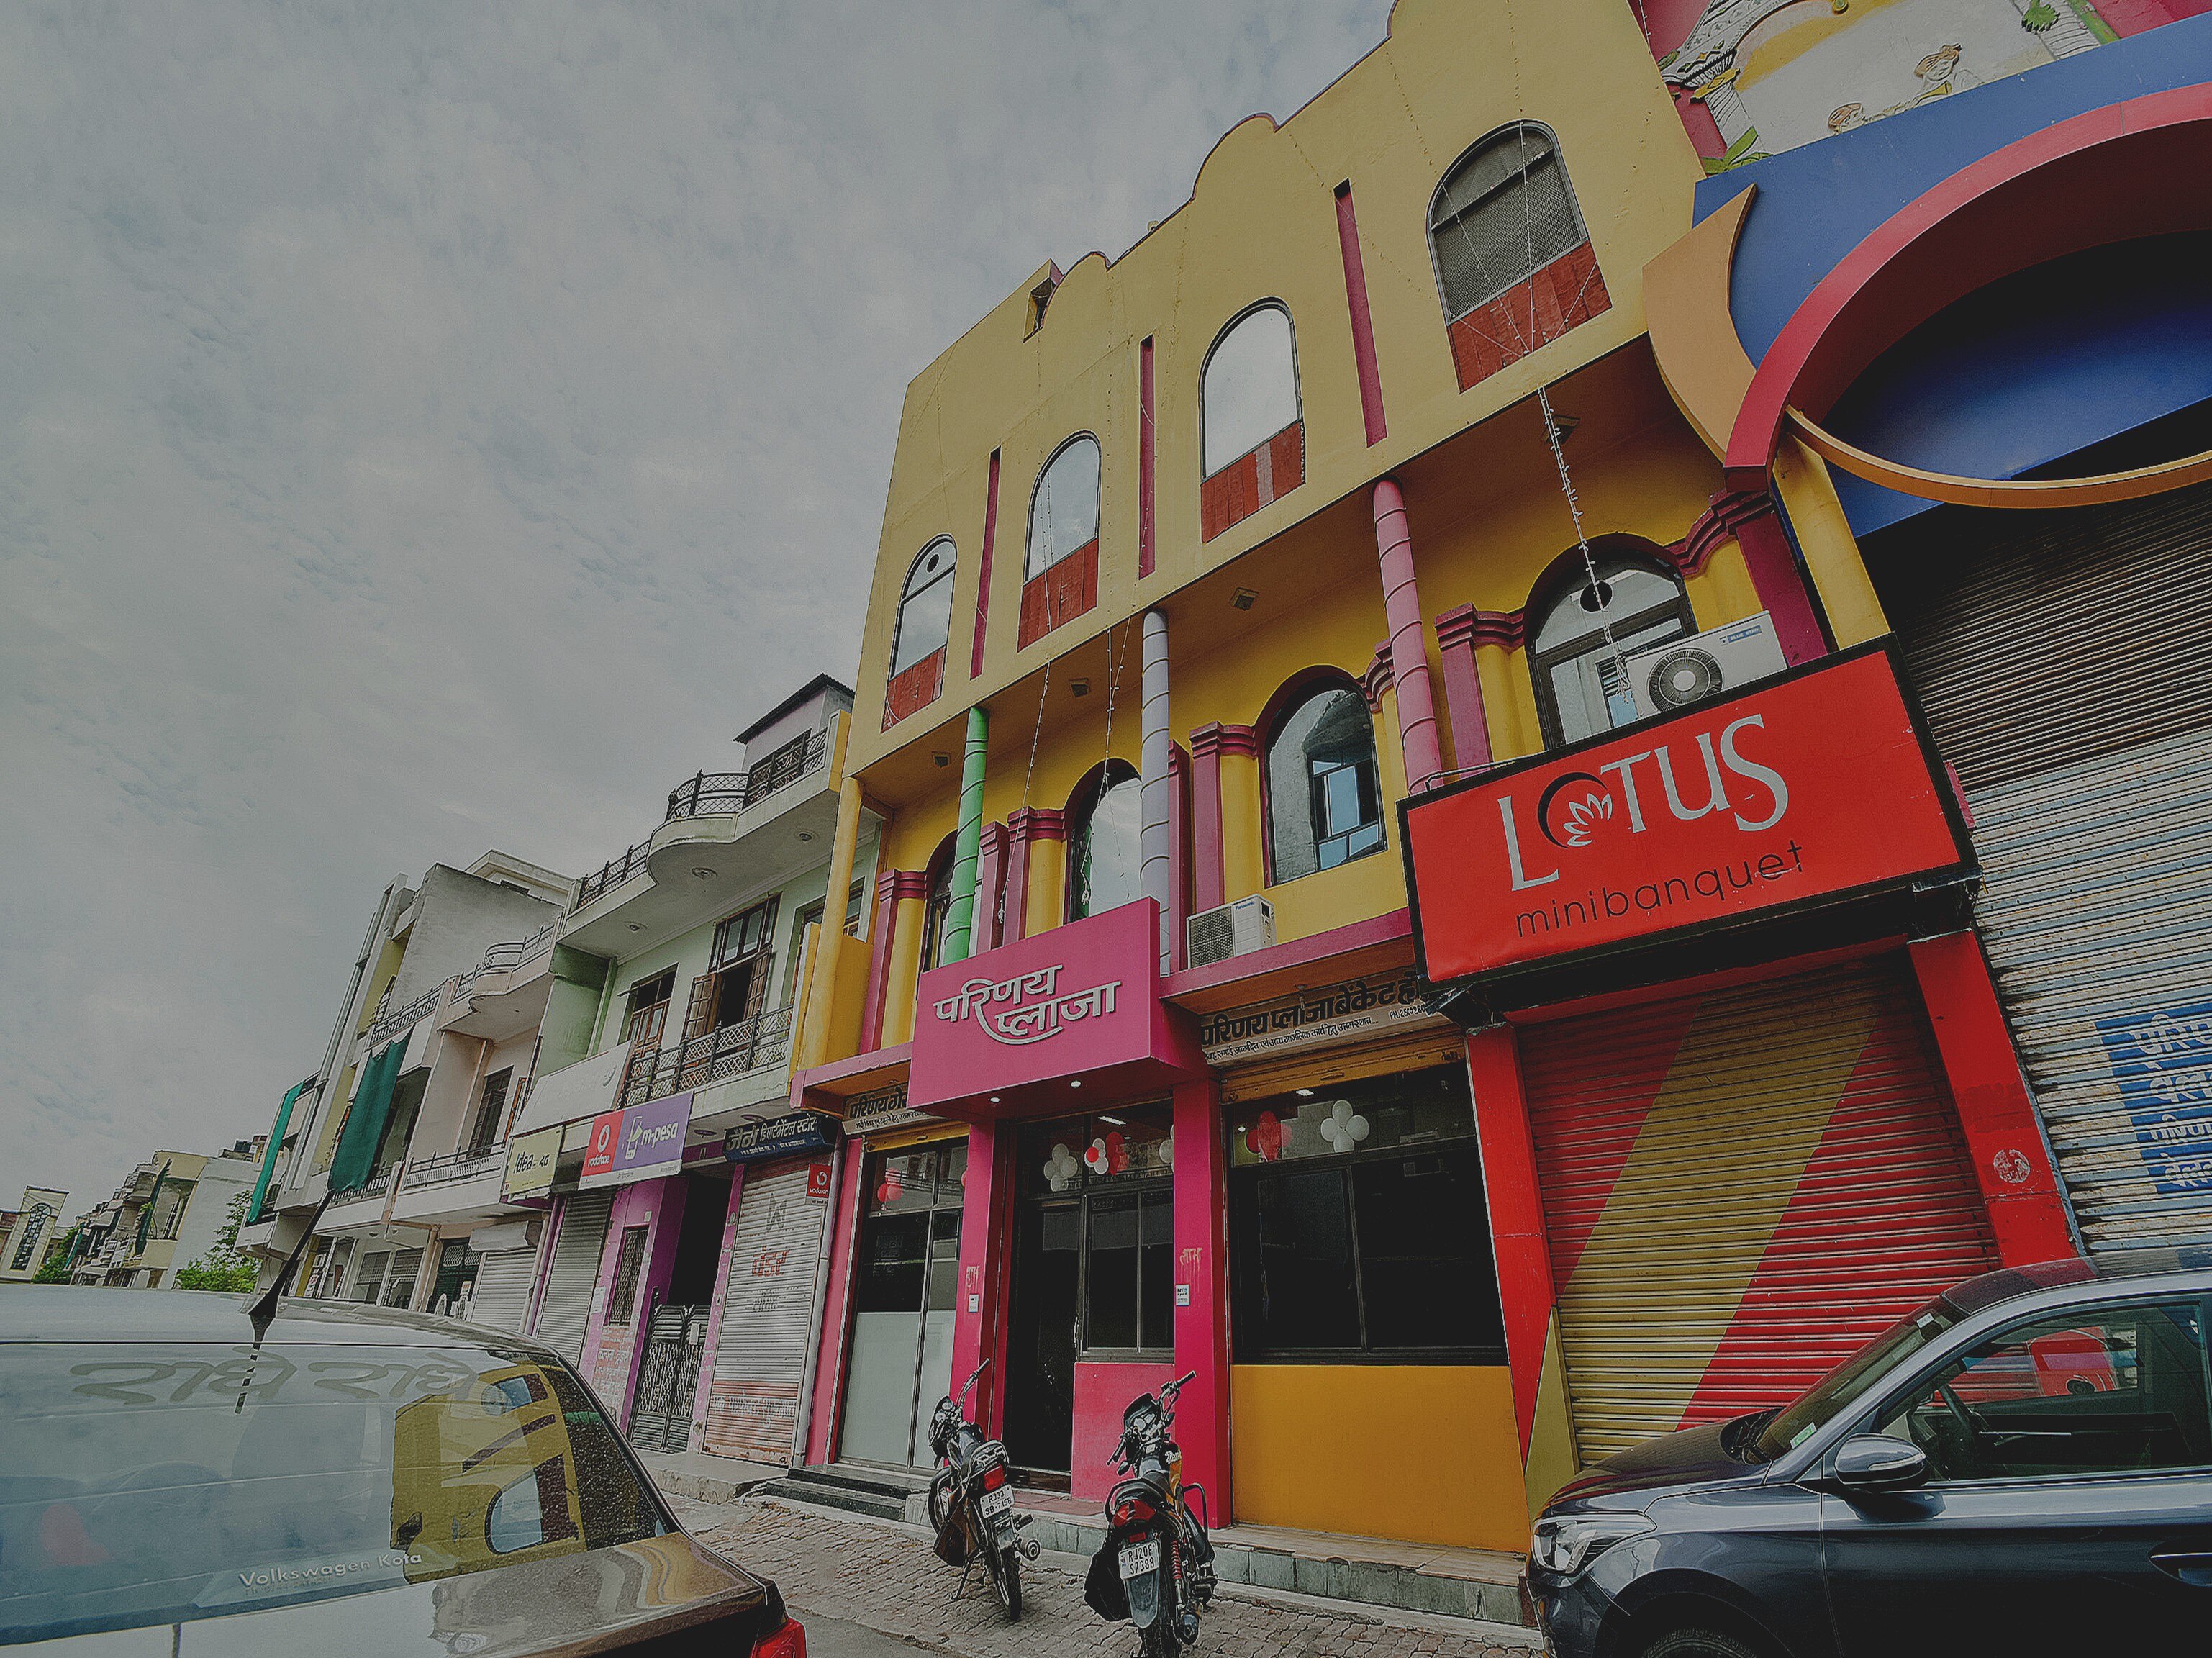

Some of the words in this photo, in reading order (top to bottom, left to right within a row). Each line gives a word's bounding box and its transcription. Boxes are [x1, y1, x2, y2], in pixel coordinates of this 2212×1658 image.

[1497, 713, 1790, 892] LOTUS
[1516, 840, 1803, 937] minibanquet
[933, 964, 1064, 1045] परिणय
[994, 980, 1121, 1037] प्लाजा
[640, 1122, 679, 1149] m-pesa
[587, 1154, 611, 1168] vodafone
[988, 1490, 1005, 1503] RJ33
[1128, 1544, 1152, 1563] RJ20F
[1129, 1557, 1155, 1575] S7388
[238, 1559, 371, 1587] Volkswagen
[377, 1553, 423, 1568] Kota
